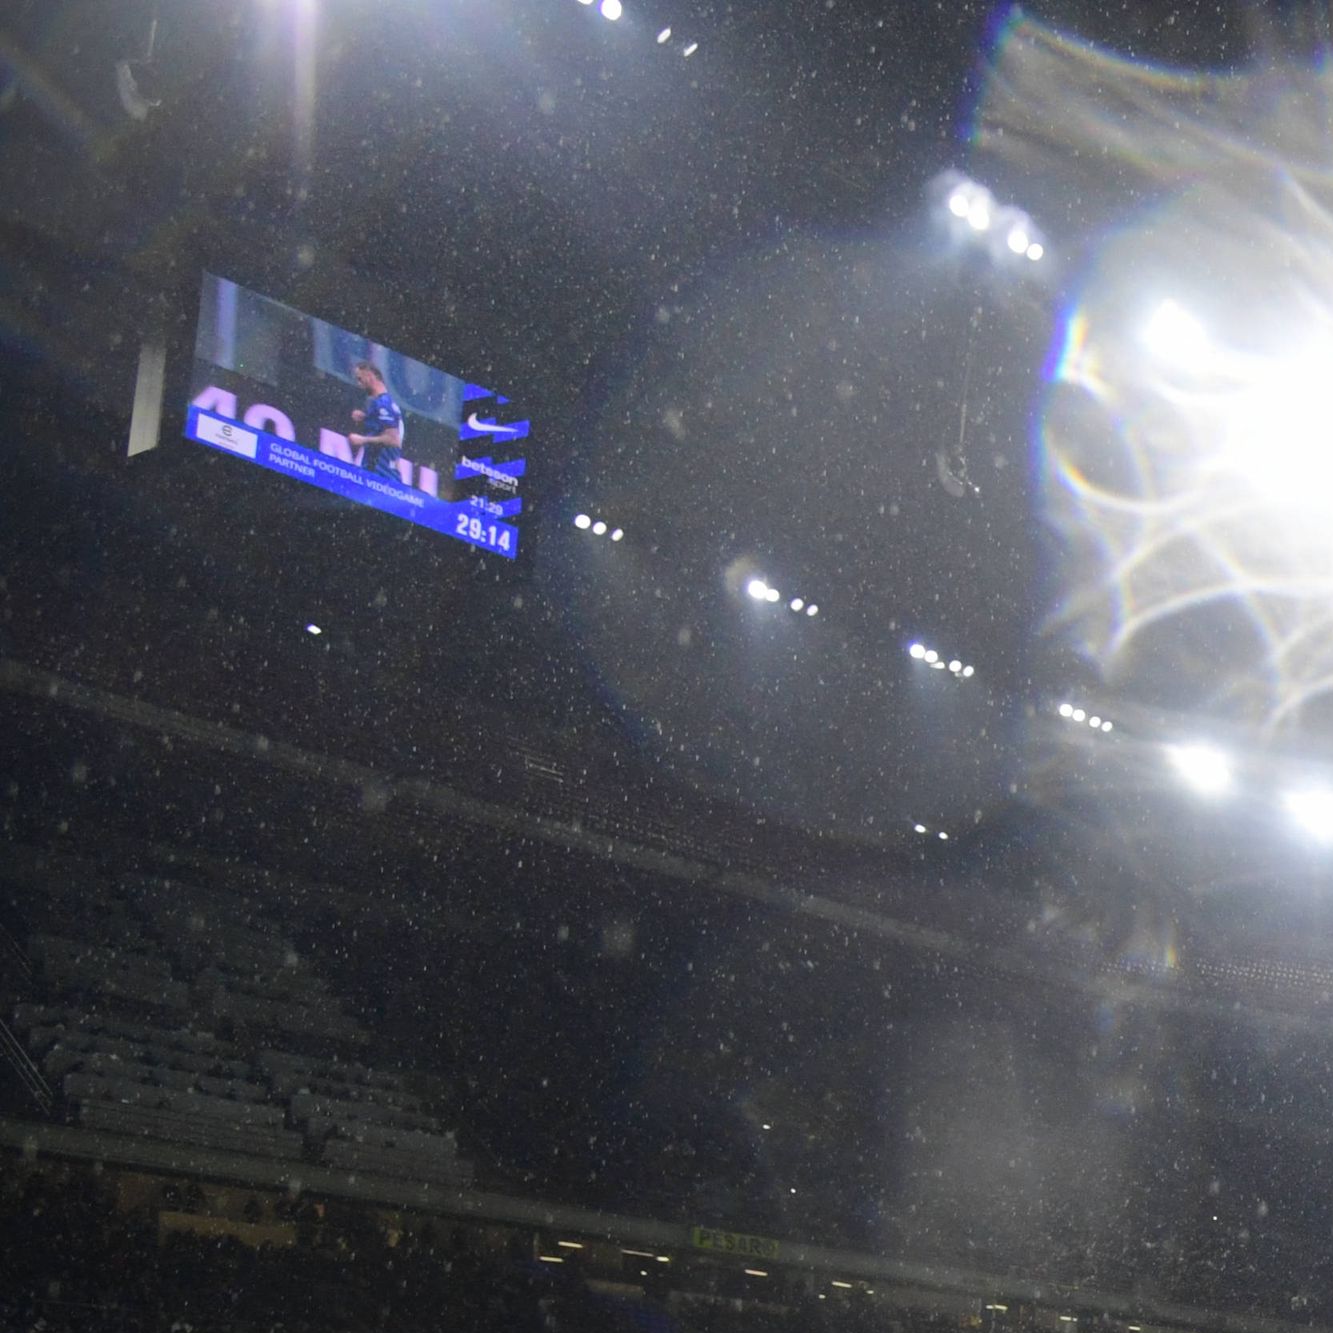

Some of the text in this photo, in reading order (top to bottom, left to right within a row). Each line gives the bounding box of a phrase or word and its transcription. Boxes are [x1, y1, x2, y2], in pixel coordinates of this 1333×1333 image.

[269, 453, 316, 478] PARTNER
[270, 443, 425, 508] GLOBAL FOOTBALL VIDEOGAME
[461, 455, 519, 487] betsson
[470, 495, 503, 515] 21:29
[456, 513, 511, 552] 29:14
